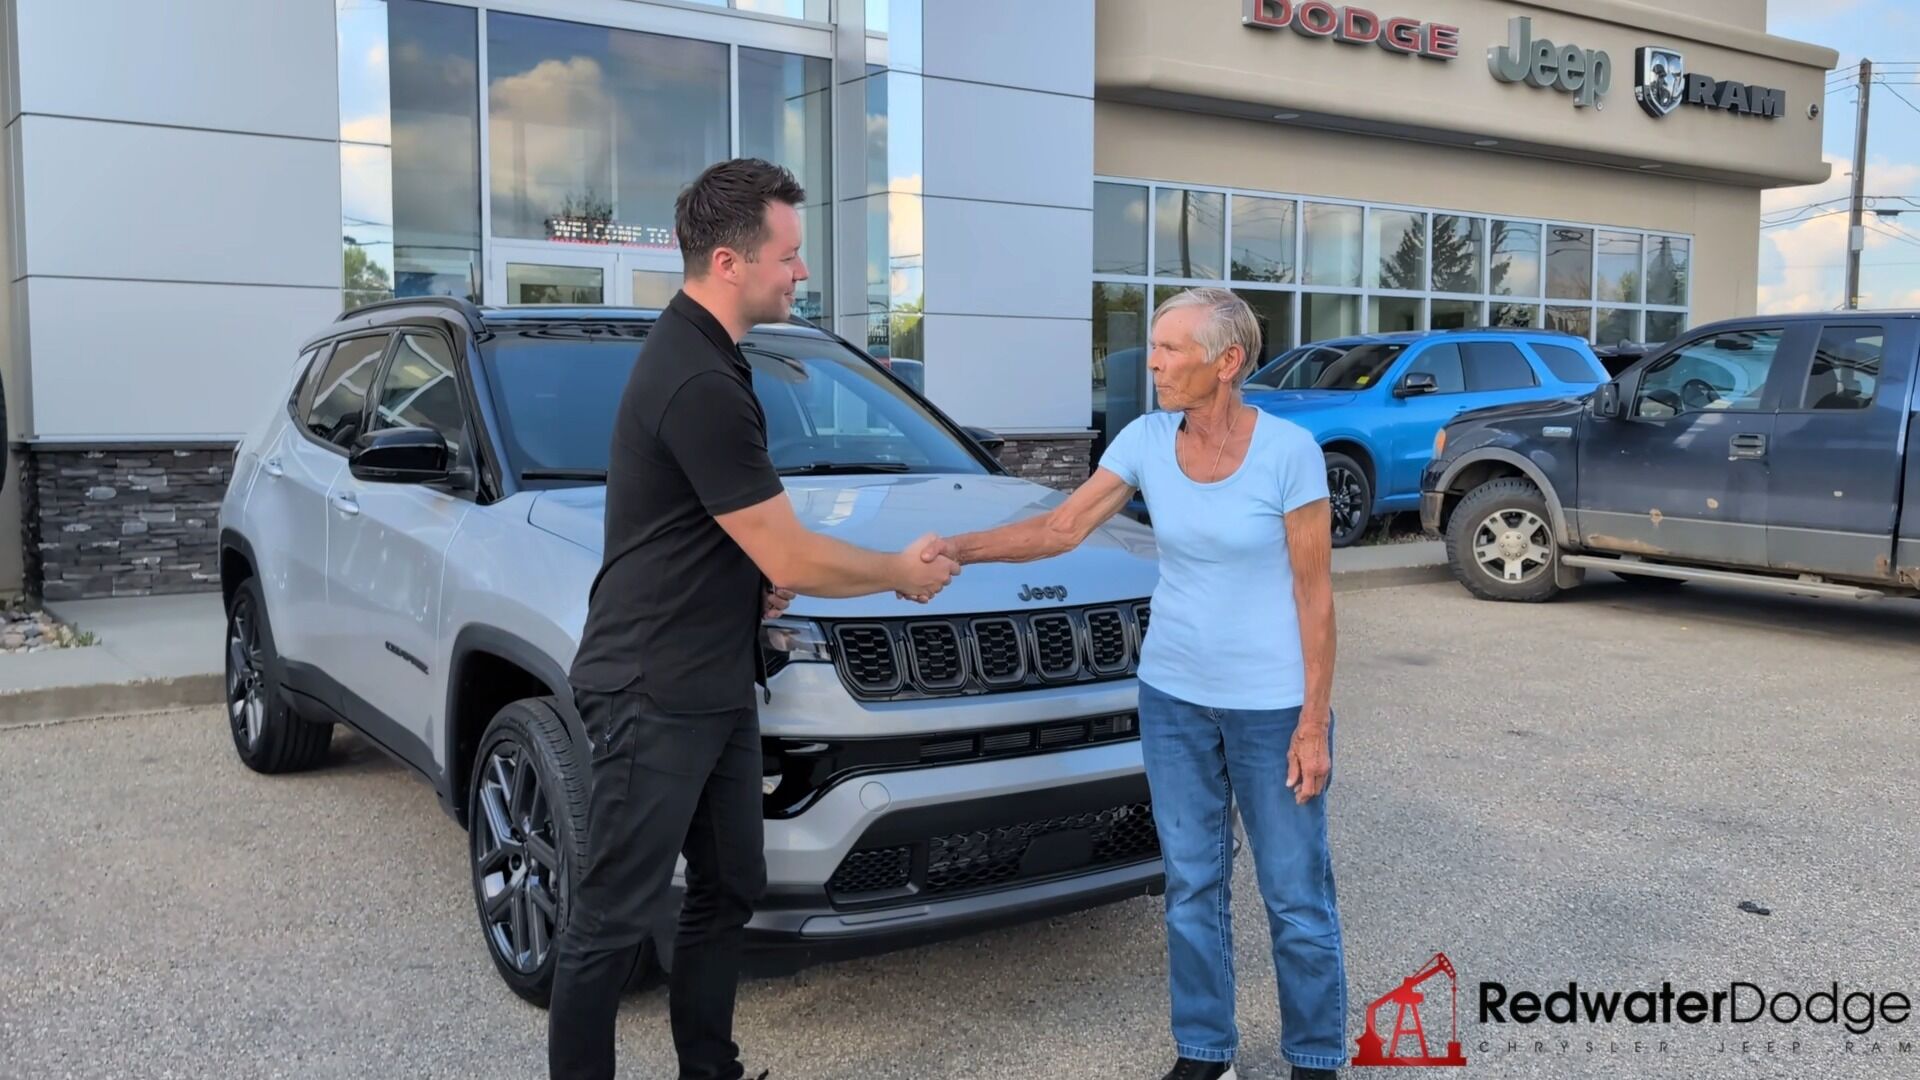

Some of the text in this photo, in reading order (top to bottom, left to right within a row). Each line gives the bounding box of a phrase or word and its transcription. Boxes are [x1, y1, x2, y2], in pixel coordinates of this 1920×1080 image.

[1243, 0, 1460, 59] DODGE
[1487, 16, 1612, 108] Jeep
[1684, 73, 1786, 118] RAM
[1017, 583, 1068, 602] Jeep
